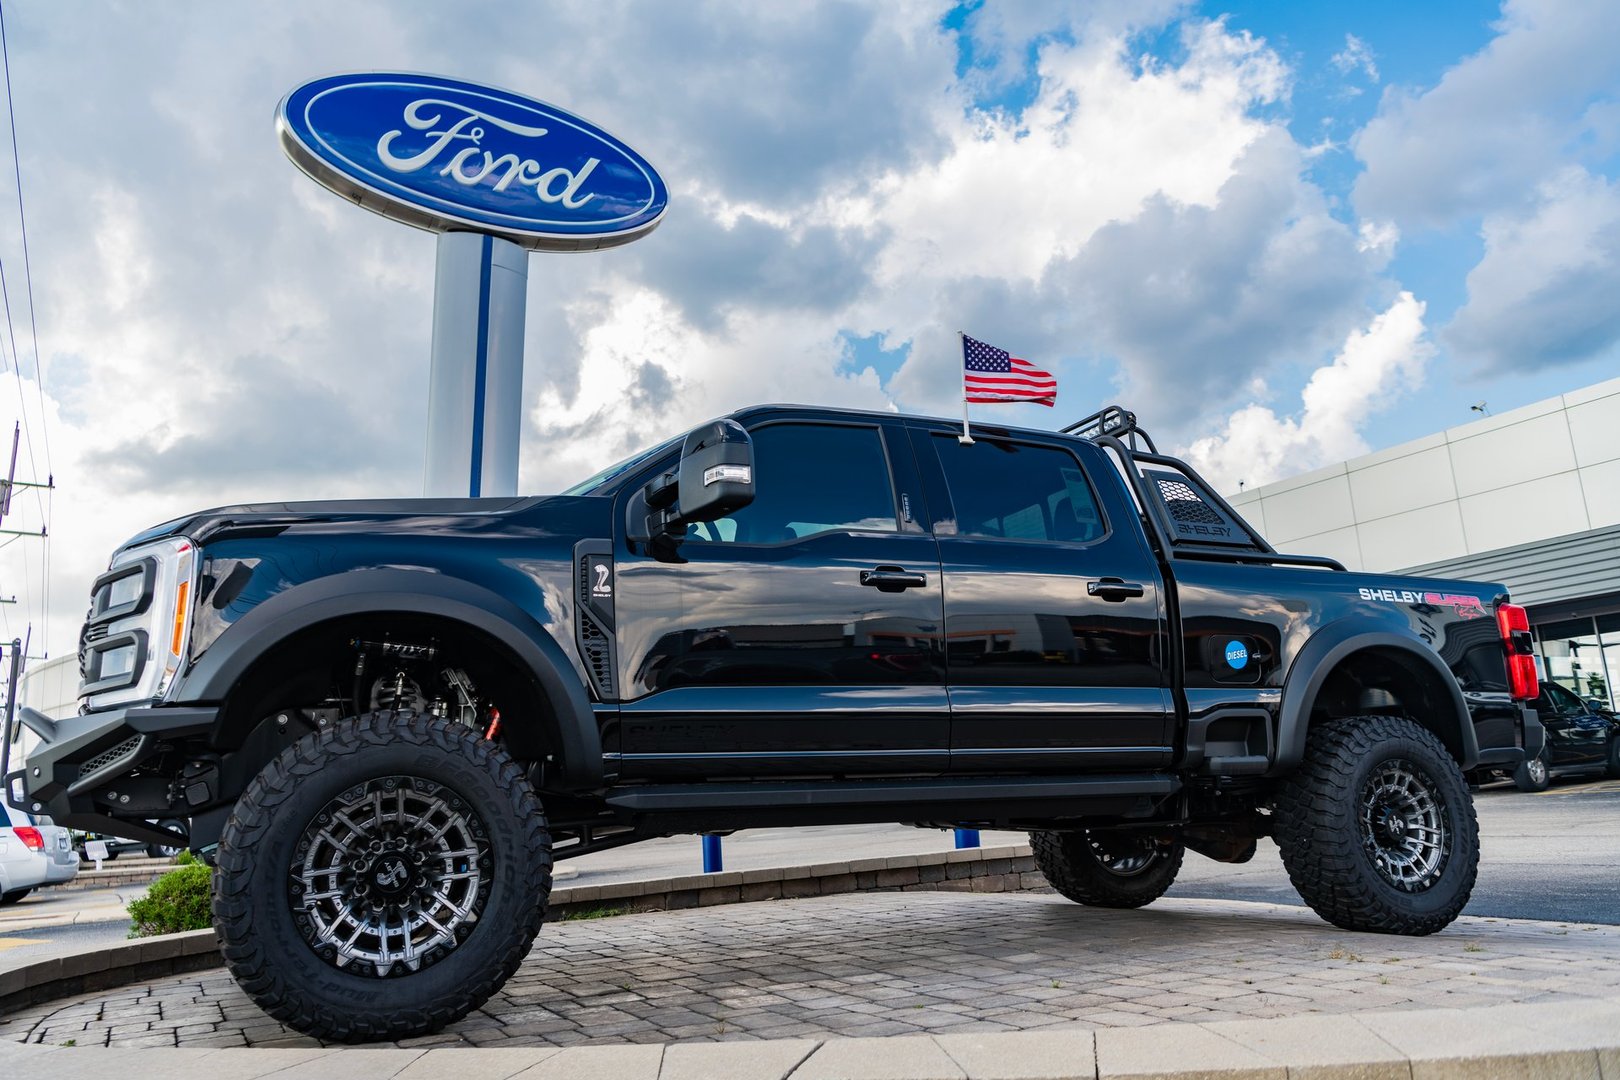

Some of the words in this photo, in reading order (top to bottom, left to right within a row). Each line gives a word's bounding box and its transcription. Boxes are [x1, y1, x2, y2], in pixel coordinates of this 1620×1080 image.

[377, 99, 600, 209] Ford
[1178, 523, 1231, 537] SHELBY
[1358, 587, 1423, 604] SHELBY
[1227, 649, 1248, 661] DIESEL
